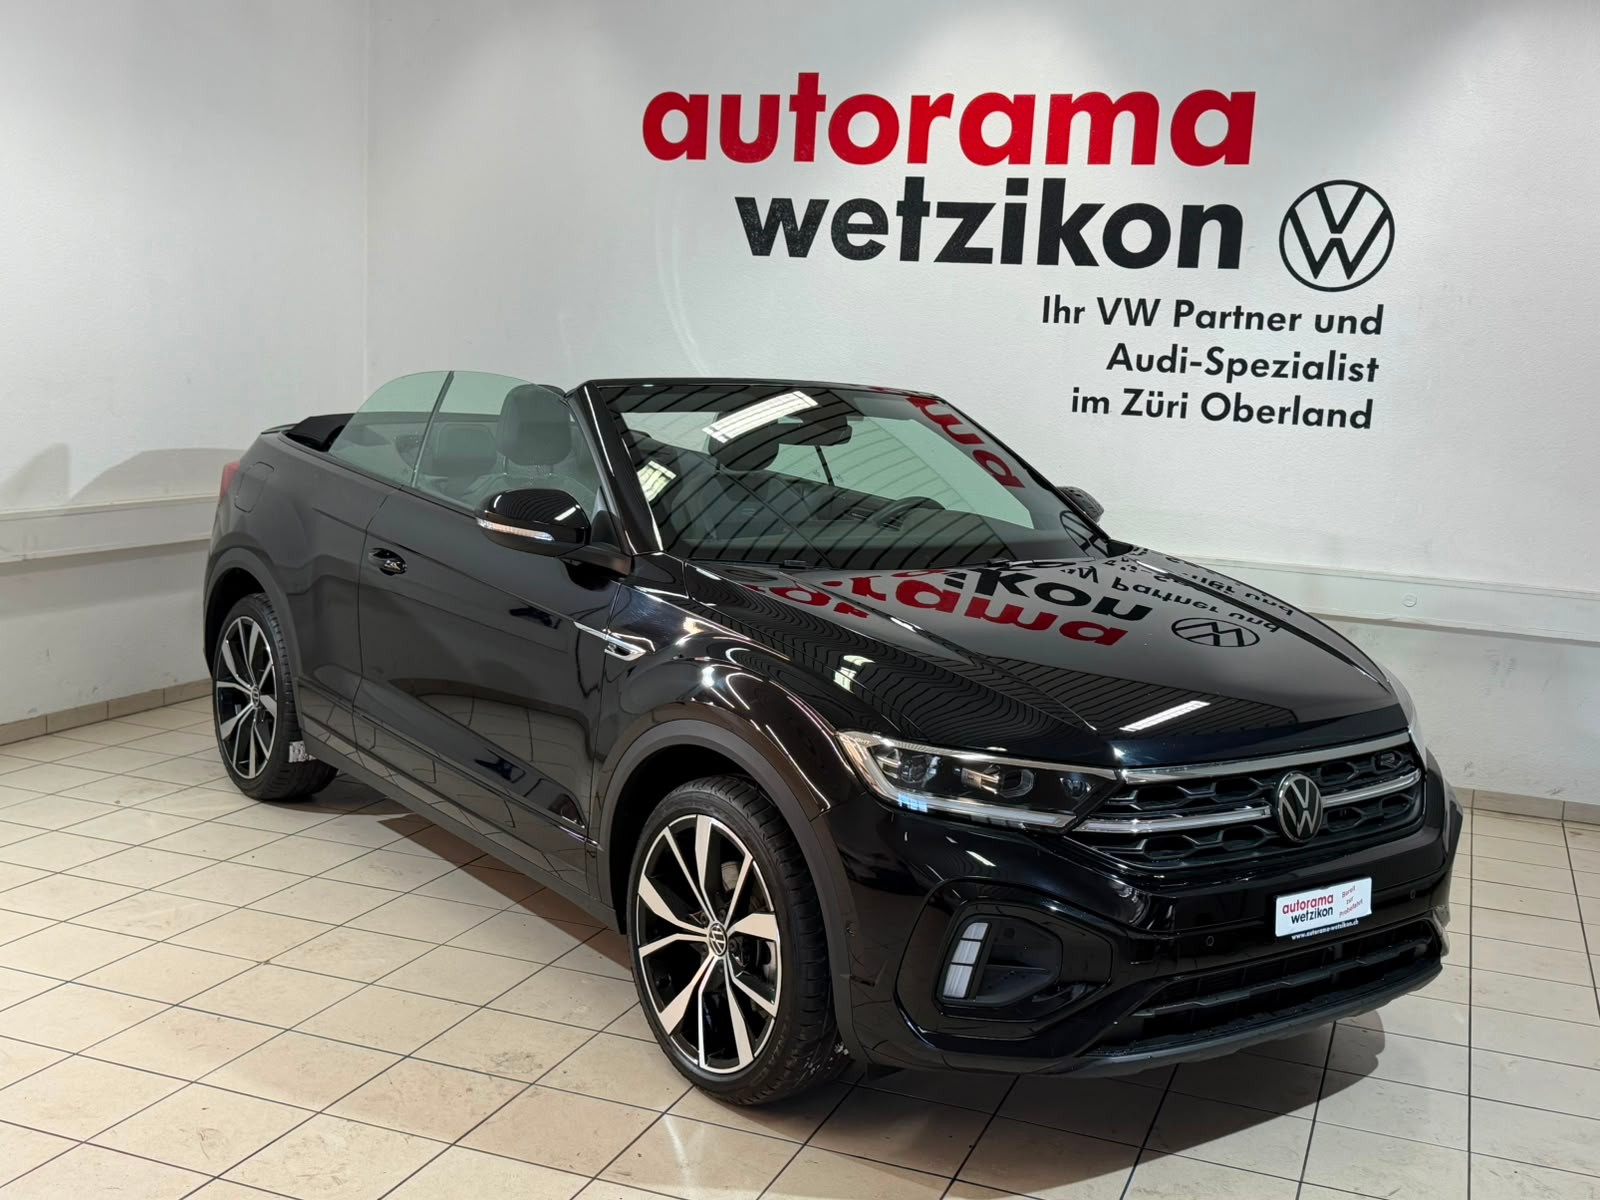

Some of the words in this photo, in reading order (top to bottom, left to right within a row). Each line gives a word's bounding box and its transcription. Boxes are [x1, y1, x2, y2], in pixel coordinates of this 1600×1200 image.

[643, 72, 1256, 167] autorama
[735, 176, 1244, 270] wetzikon
[1042, 295, 1086, 324] Ihr
[1096, 296, 1161, 327] VW
[1173, 299, 1302, 332] Partner
[1314, 303, 1384, 335] und
[1106, 342, 1380, 384] Audi-Spezialist
[1071, 386, 1109, 415] im
[1121, 387, 1189, 420] Züri
[1200, 391, 1373, 430] Oberland
[1282, 894, 1334, 915] autorama
[1291, 906, 1334, 925] wetzikon
